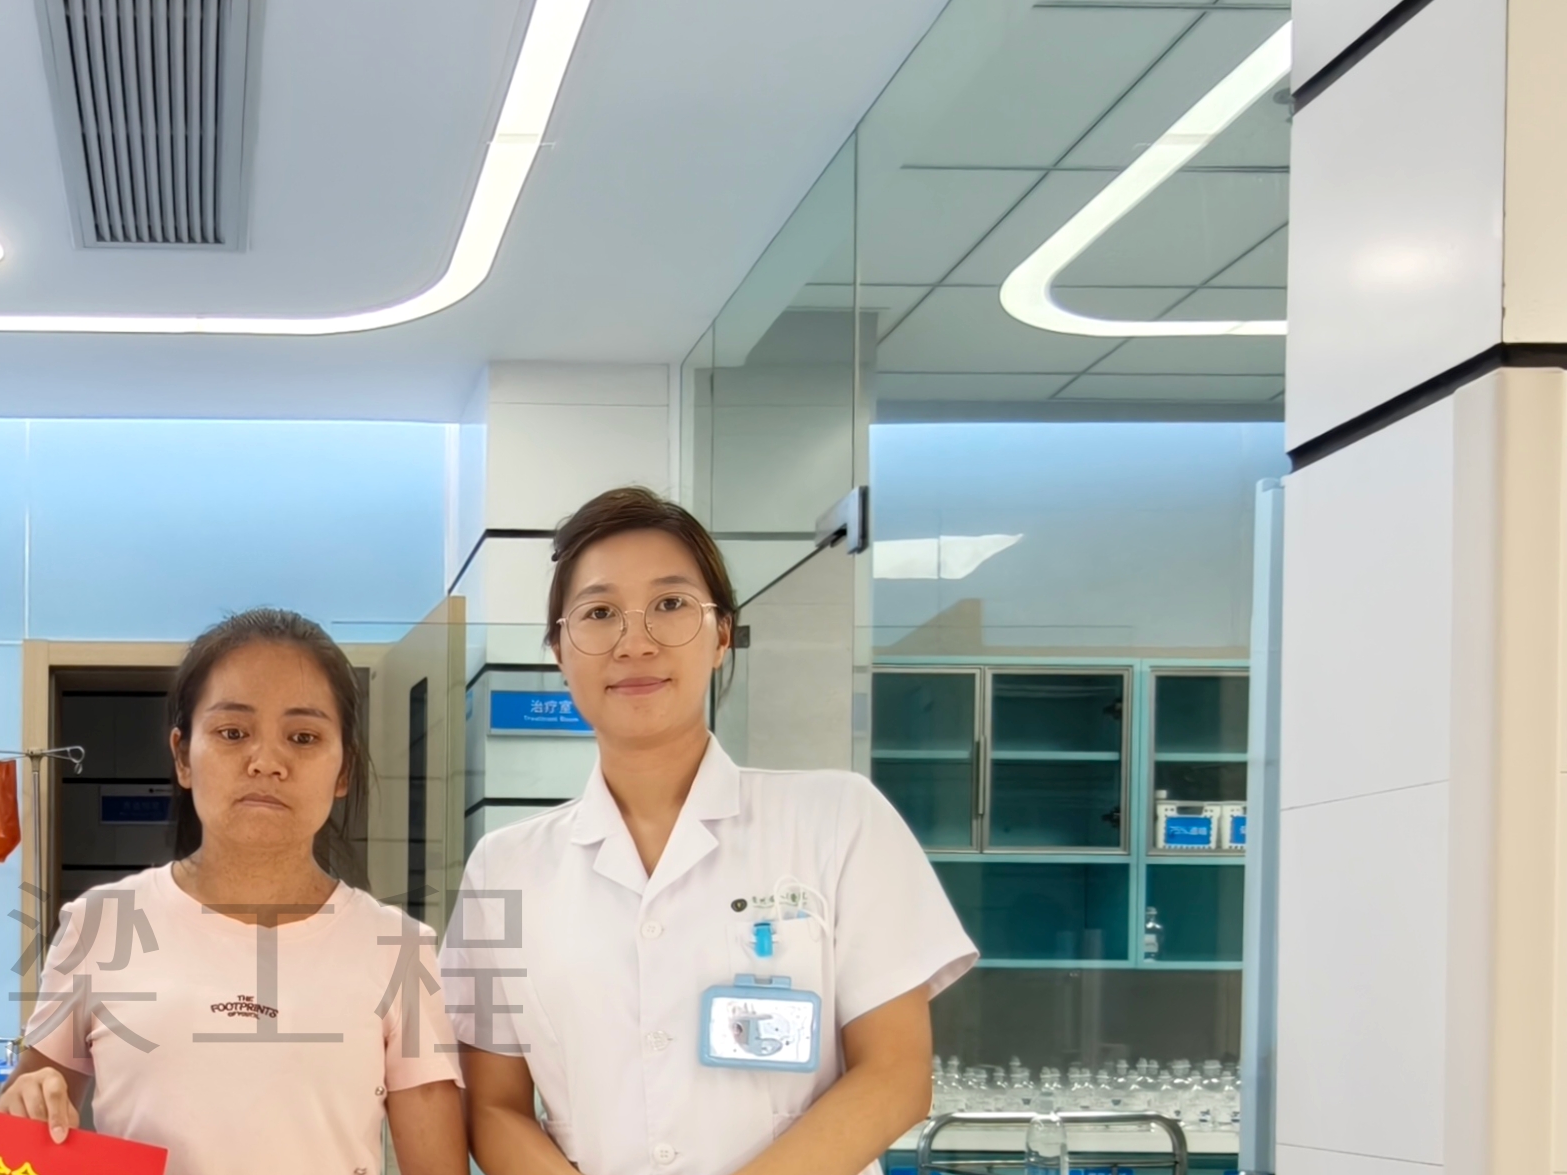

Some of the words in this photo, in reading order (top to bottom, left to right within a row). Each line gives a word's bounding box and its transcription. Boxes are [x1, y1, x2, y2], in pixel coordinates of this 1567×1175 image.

[530, 699, 573, 714] 治疗室
[210, 1002, 279, 1018] FOOTPRINTS
